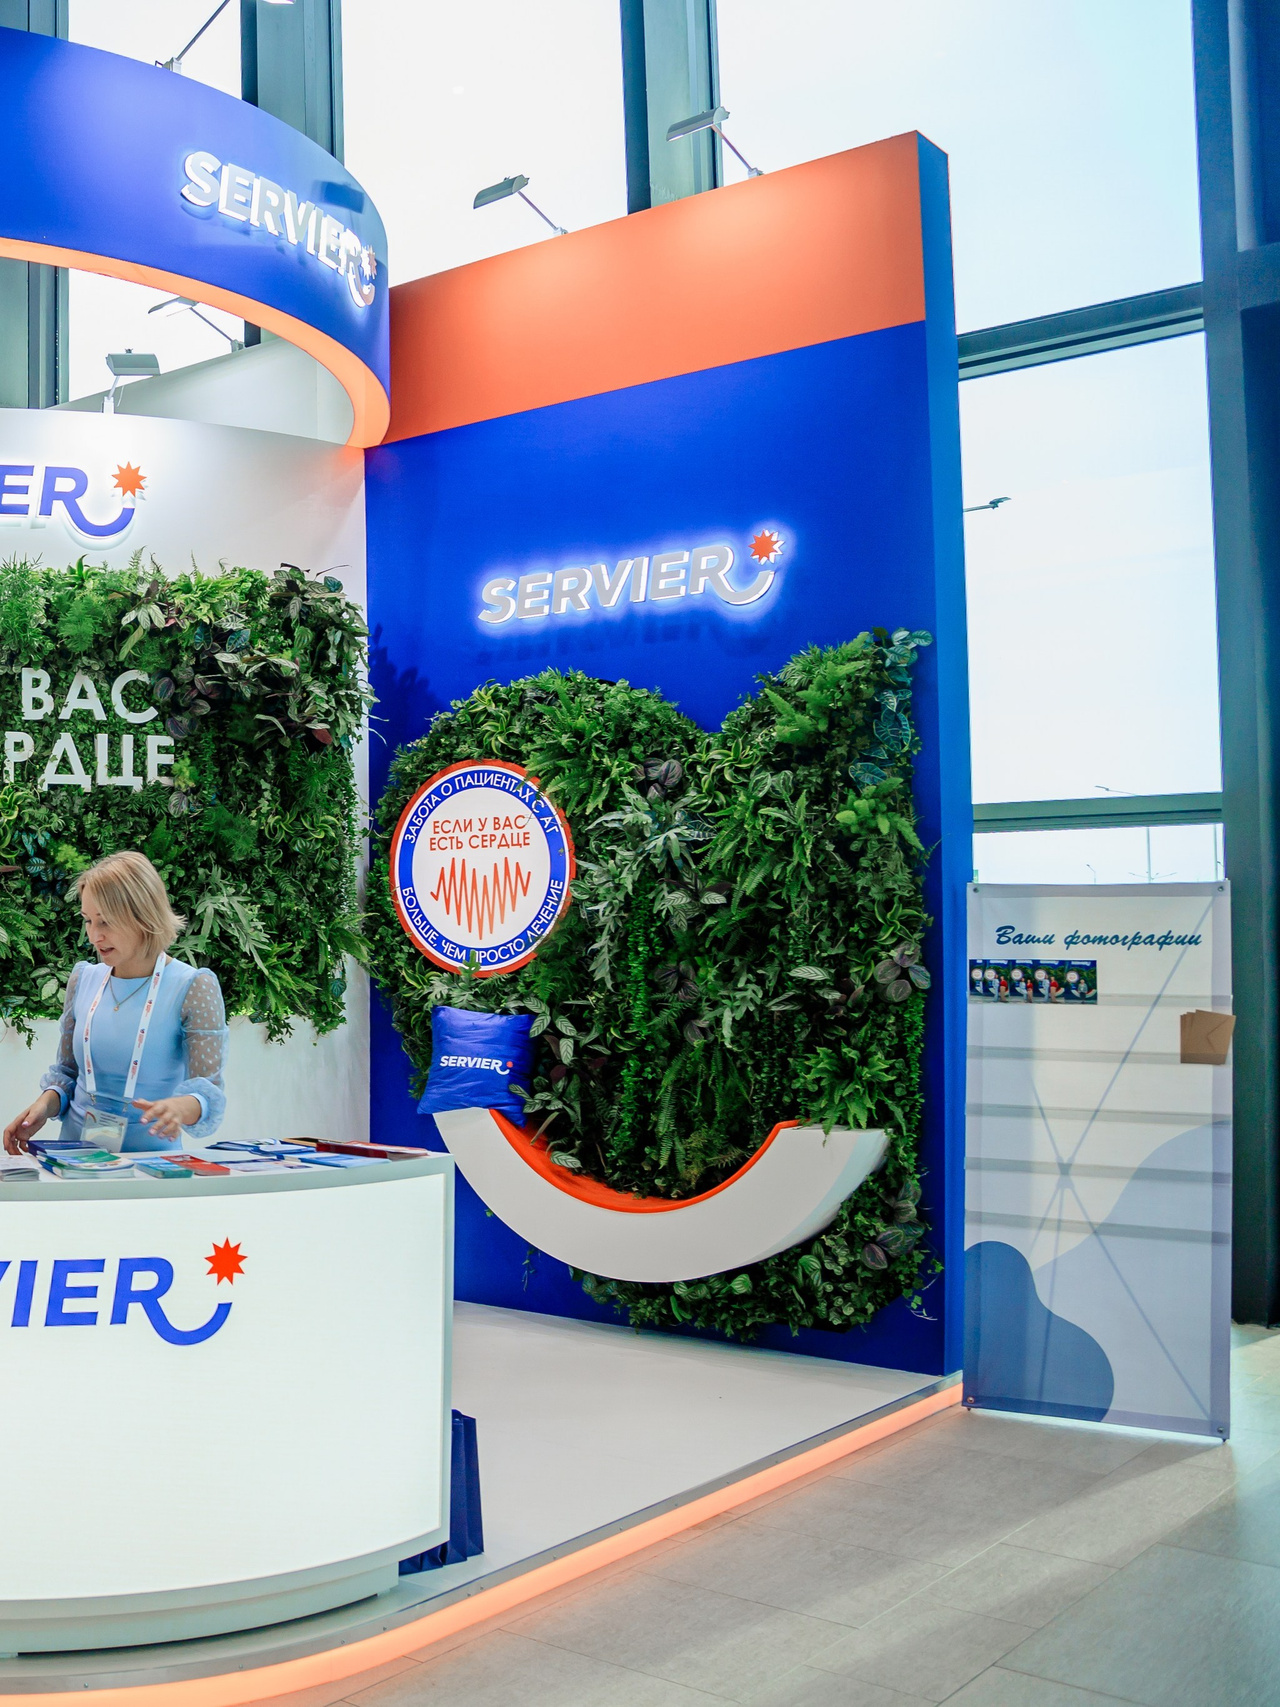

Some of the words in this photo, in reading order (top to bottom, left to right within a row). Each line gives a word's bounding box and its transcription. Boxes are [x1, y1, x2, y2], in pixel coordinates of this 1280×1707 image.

[181, 151, 376, 307] SERVIER
[477, 545, 775, 624] SERVIER
[21, 667, 159, 724] ВАС
[405, 794, 441, 844] ЗАБОТА
[441, 784, 453, 796] О
[455, 772, 534, 803] ПАЦИЕНТАХ
[540, 816, 559, 834] АГ
[432, 819, 473, 835] ЕСЛИ
[478, 817, 488, 832] У
[493, 814, 526, 830] ВАС
[429, 836, 463, 851] ЕСТЬ
[468, 832, 531, 850] СЕРДЦЕ
[402, 886, 439, 947] БОЛЬШЕ,
[441, 938, 466, 962] ЧЕМ
[528, 879, 564, 943] ЛЕЧЕНИЕ
[995, 925, 1056, 945] Ваши
[1063, 929, 1203, 951] фотографии
[440, 1055, 510, 1075] SERVIER
